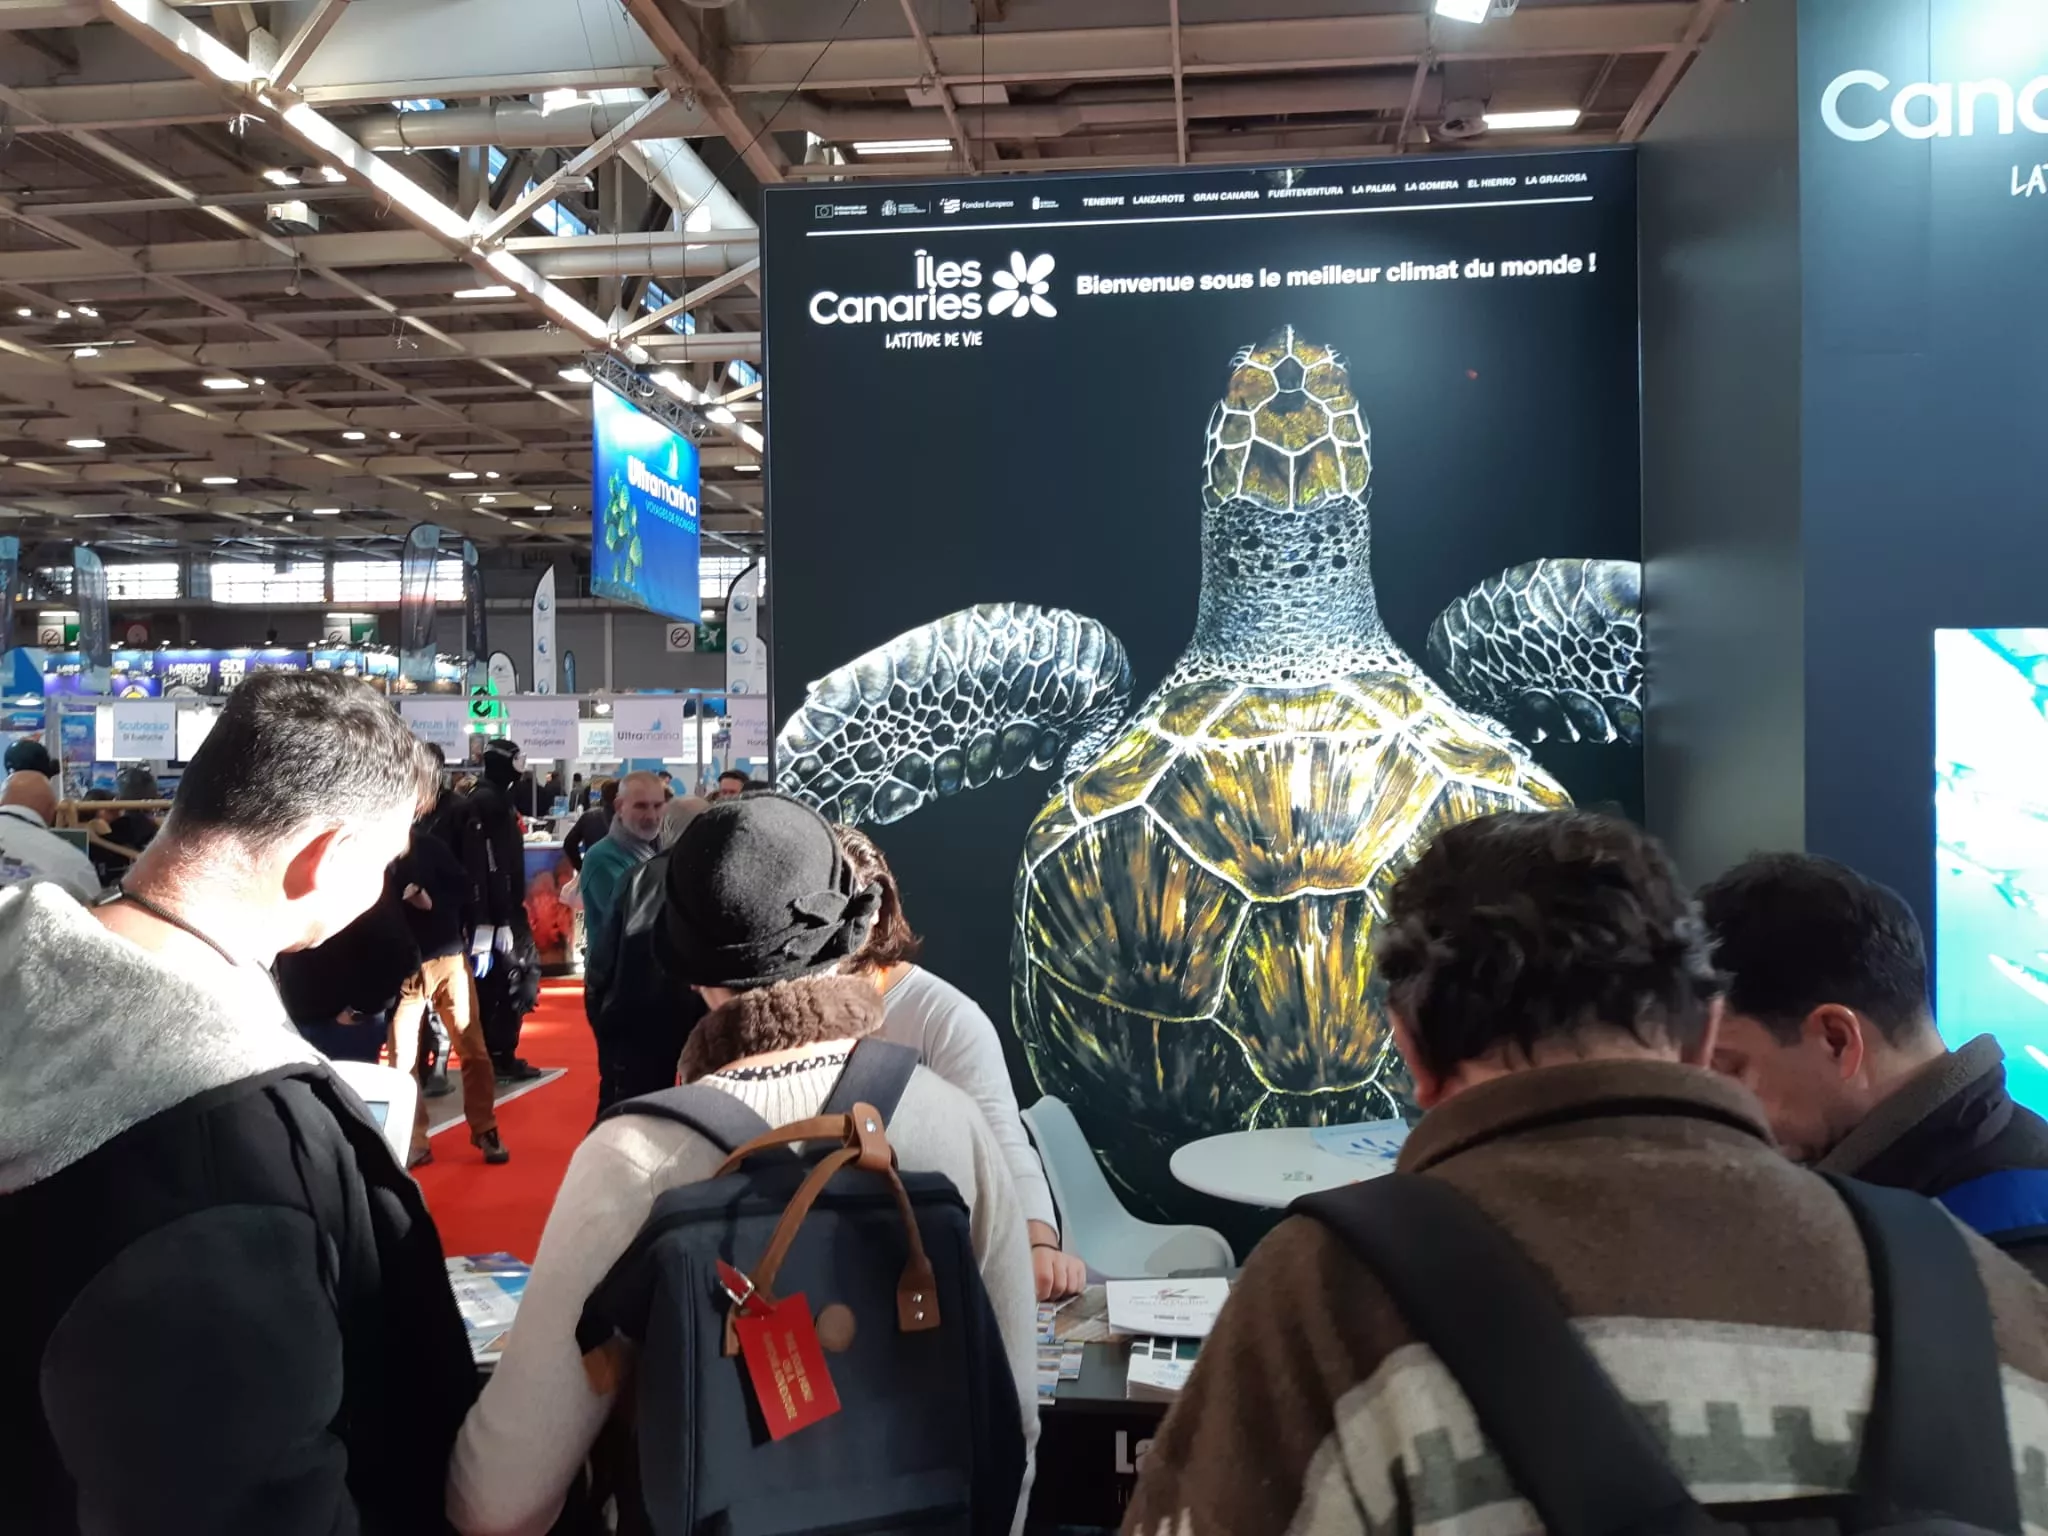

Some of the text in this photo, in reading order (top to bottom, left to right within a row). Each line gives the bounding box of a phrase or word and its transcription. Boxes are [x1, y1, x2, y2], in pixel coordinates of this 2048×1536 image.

[1404, 180, 1459, 192] LA GOMERA
[1467, 177, 1517, 189] EL HIERRO
[1525, 173, 1588, 186] LA GRACIOSA
[1267, 185, 1344, 199] FUERTEVENTURA
[1351, 183, 1397, 195] LA PALMA
[1082, 196, 1125, 207] TENERIFE
[1132, 193, 1185, 205] LANZAROTE
[1193, 190, 1260, 203] GRAN CANARIA
[914, 249, 983, 289] Îles
[1076, 252, 1597, 295] Bienvenue sous le meilleur climat du monde !
[809, 288, 983, 325] Canaries
[885, 331, 983, 349] LATITUDE DE VIE
[627, 454, 697, 518] Ultramarina
[617, 730, 680, 742] Ultramarina
